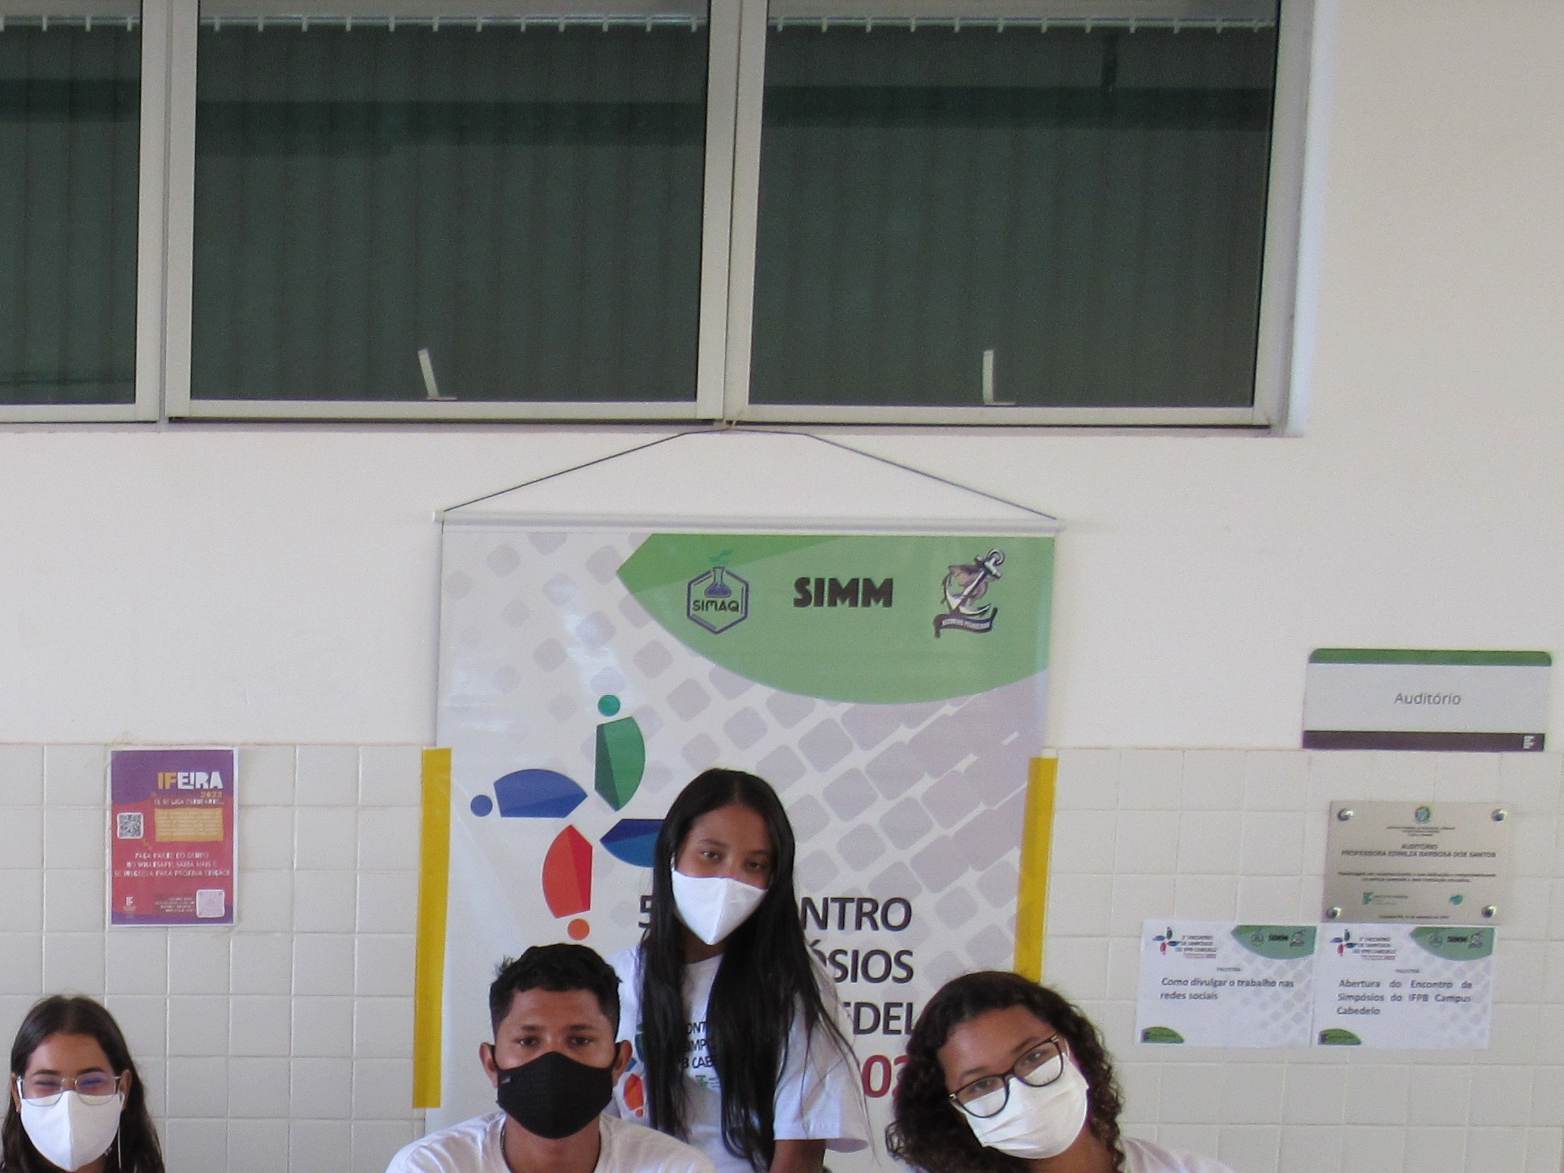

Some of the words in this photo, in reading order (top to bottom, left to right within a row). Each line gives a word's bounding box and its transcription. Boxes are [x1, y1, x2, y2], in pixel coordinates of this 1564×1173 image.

[793, 577, 894, 608] SIMM
[692, 599, 739, 612] SIMAQ
[1393, 692, 1462, 706] Auditório
[157, 771, 223, 790] IFEIRA
[800, 896, 912, 931] NTRO
[1161, 977, 1188, 987] Como
[1190, 977, 1226, 988] divulgar
[1237, 979, 1276, 988] trabalho
[1339, 979, 1380, 988] Abertura
[1389, 980, 1402, 988] do
[1410, 980, 1453, 989] Encontro
[1461, 981, 1472, 989] de
[1160, 991, 1186, 1000] redes
[1188, 991, 1218, 1000] sociais
[1337, 992, 1384, 1003] Simpósios
[1390, 993, 1402, 1002] do
[1408, 994, 1428, 1002] IFPB
[1434, 994, 1472, 1004] Campus
[1336, 1006, 1380, 1015] Cabedelo
[843, 1002, 916, 1035] DEL
